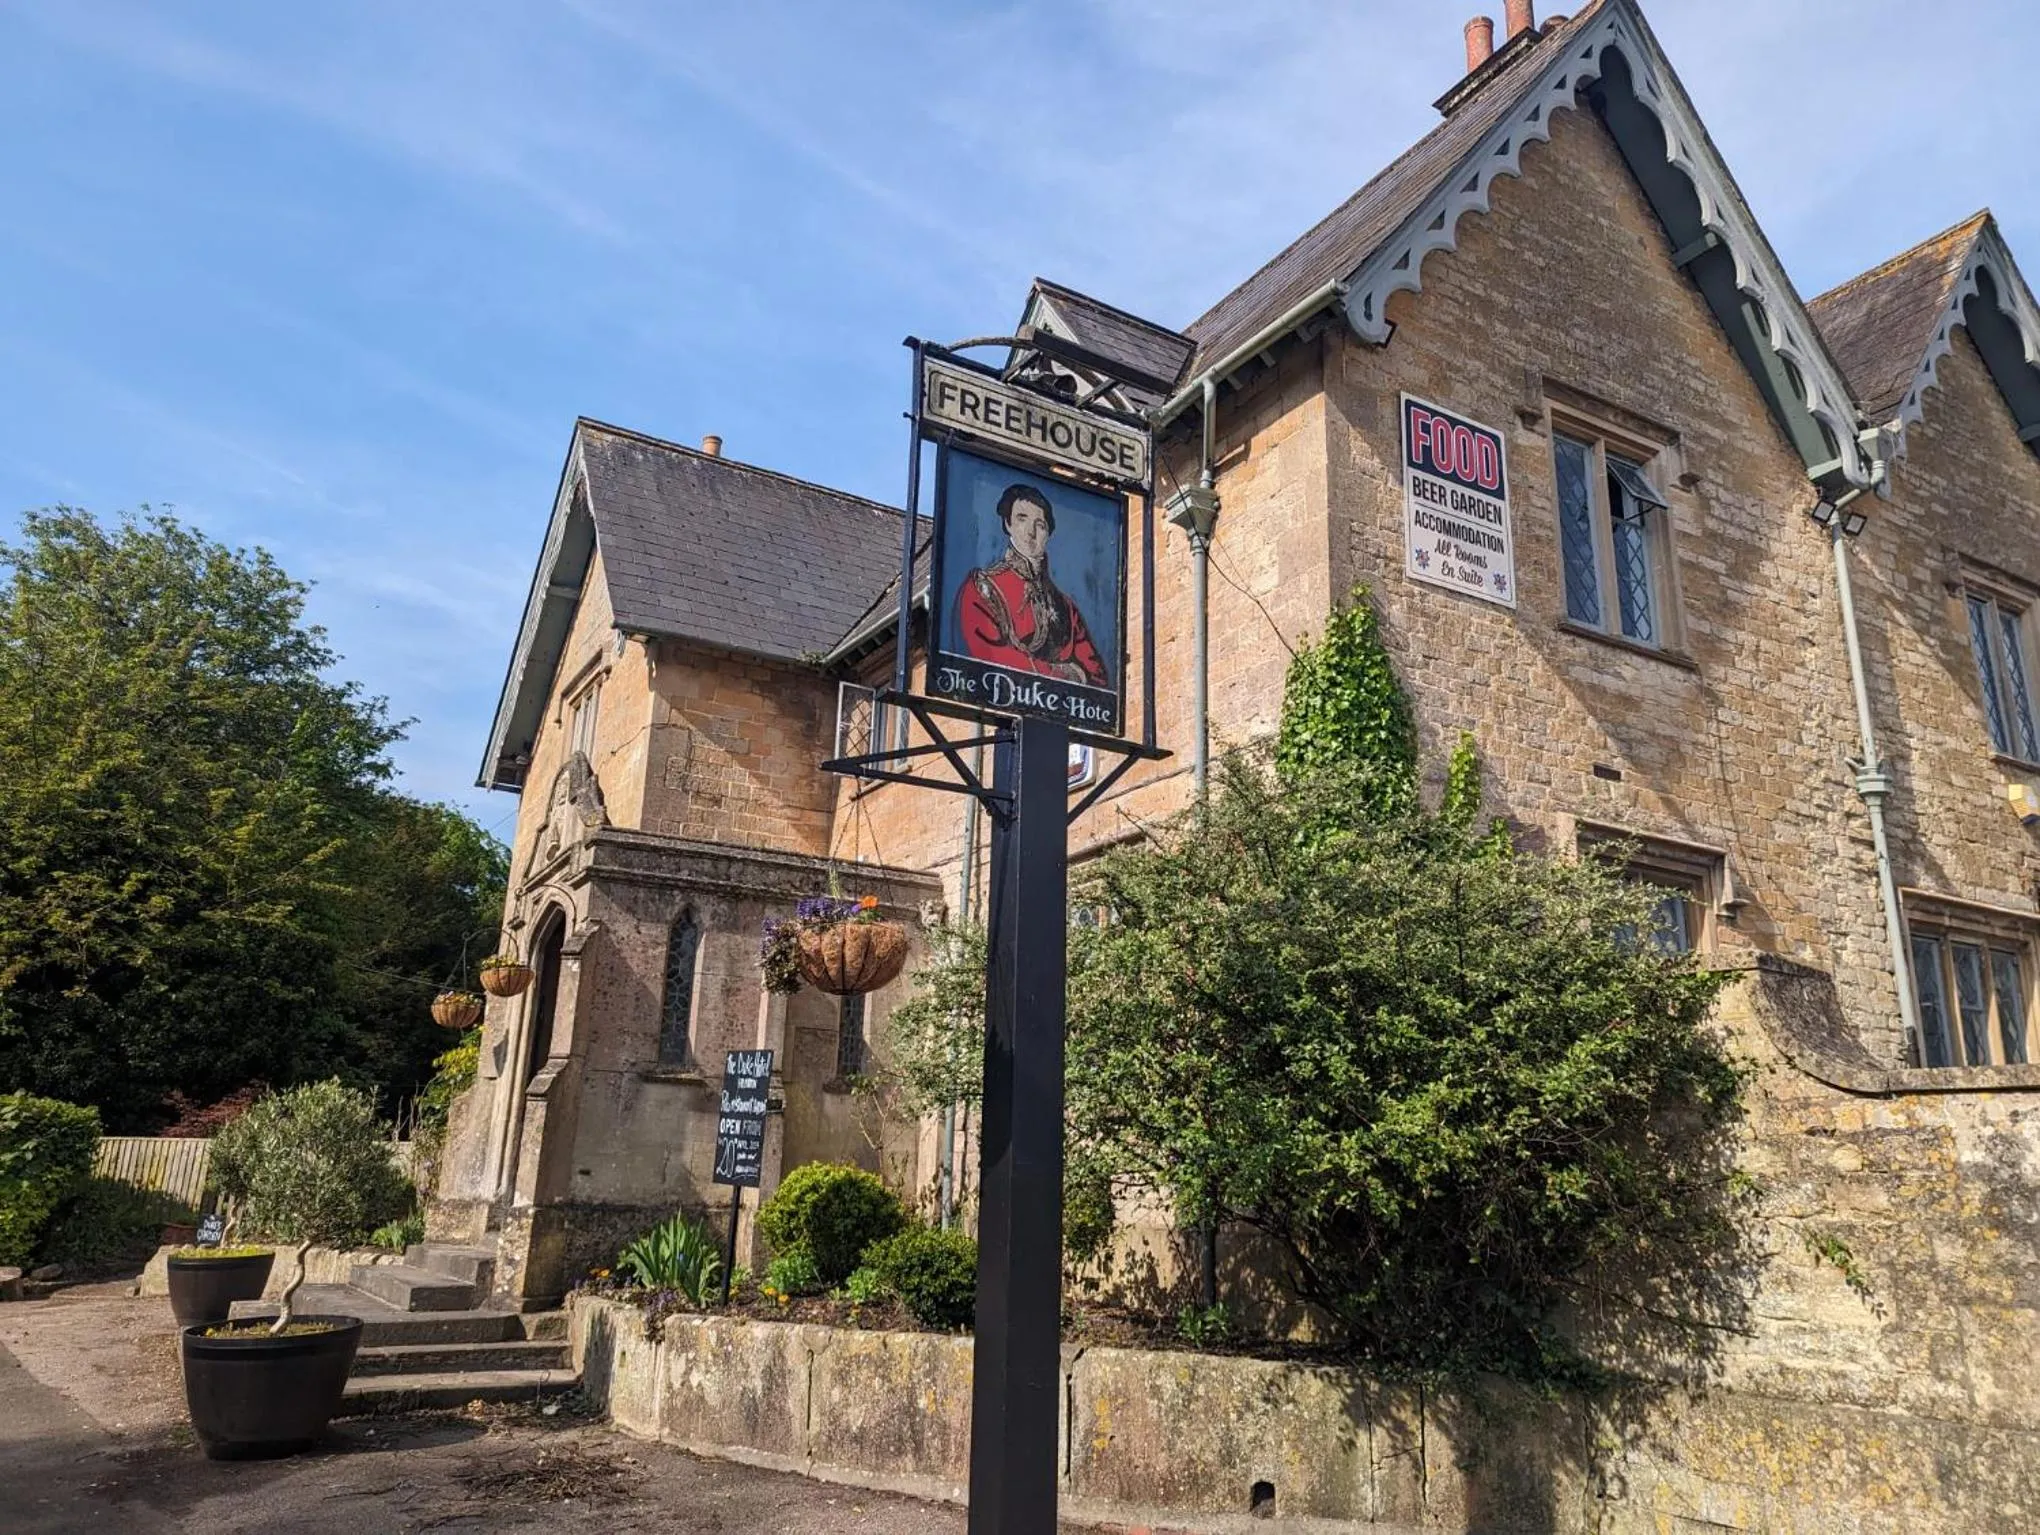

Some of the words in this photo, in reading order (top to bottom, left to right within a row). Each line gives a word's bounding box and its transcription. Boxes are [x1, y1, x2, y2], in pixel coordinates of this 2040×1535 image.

[938, 381, 1137, 473] FREEHOUSE
[1410, 406, 1500, 490] FOOD
[1412, 475, 1448, 507] BEER
[1450, 489, 1502, 526] GARDEN
[1414, 509, 1505, 555] ACCOMMODATION
[1434, 538, 1452, 557] All
[1453, 544, 1488, 569] Rooms
[1441, 560, 1455, 578] En
[1457, 565, 1484, 587] Suite
[936, 667, 976, 693] The
[982, 672, 1059, 710] Duke
[720, 1118, 741, 1135] OPEN
[742, 1119, 761, 1137] FROM
